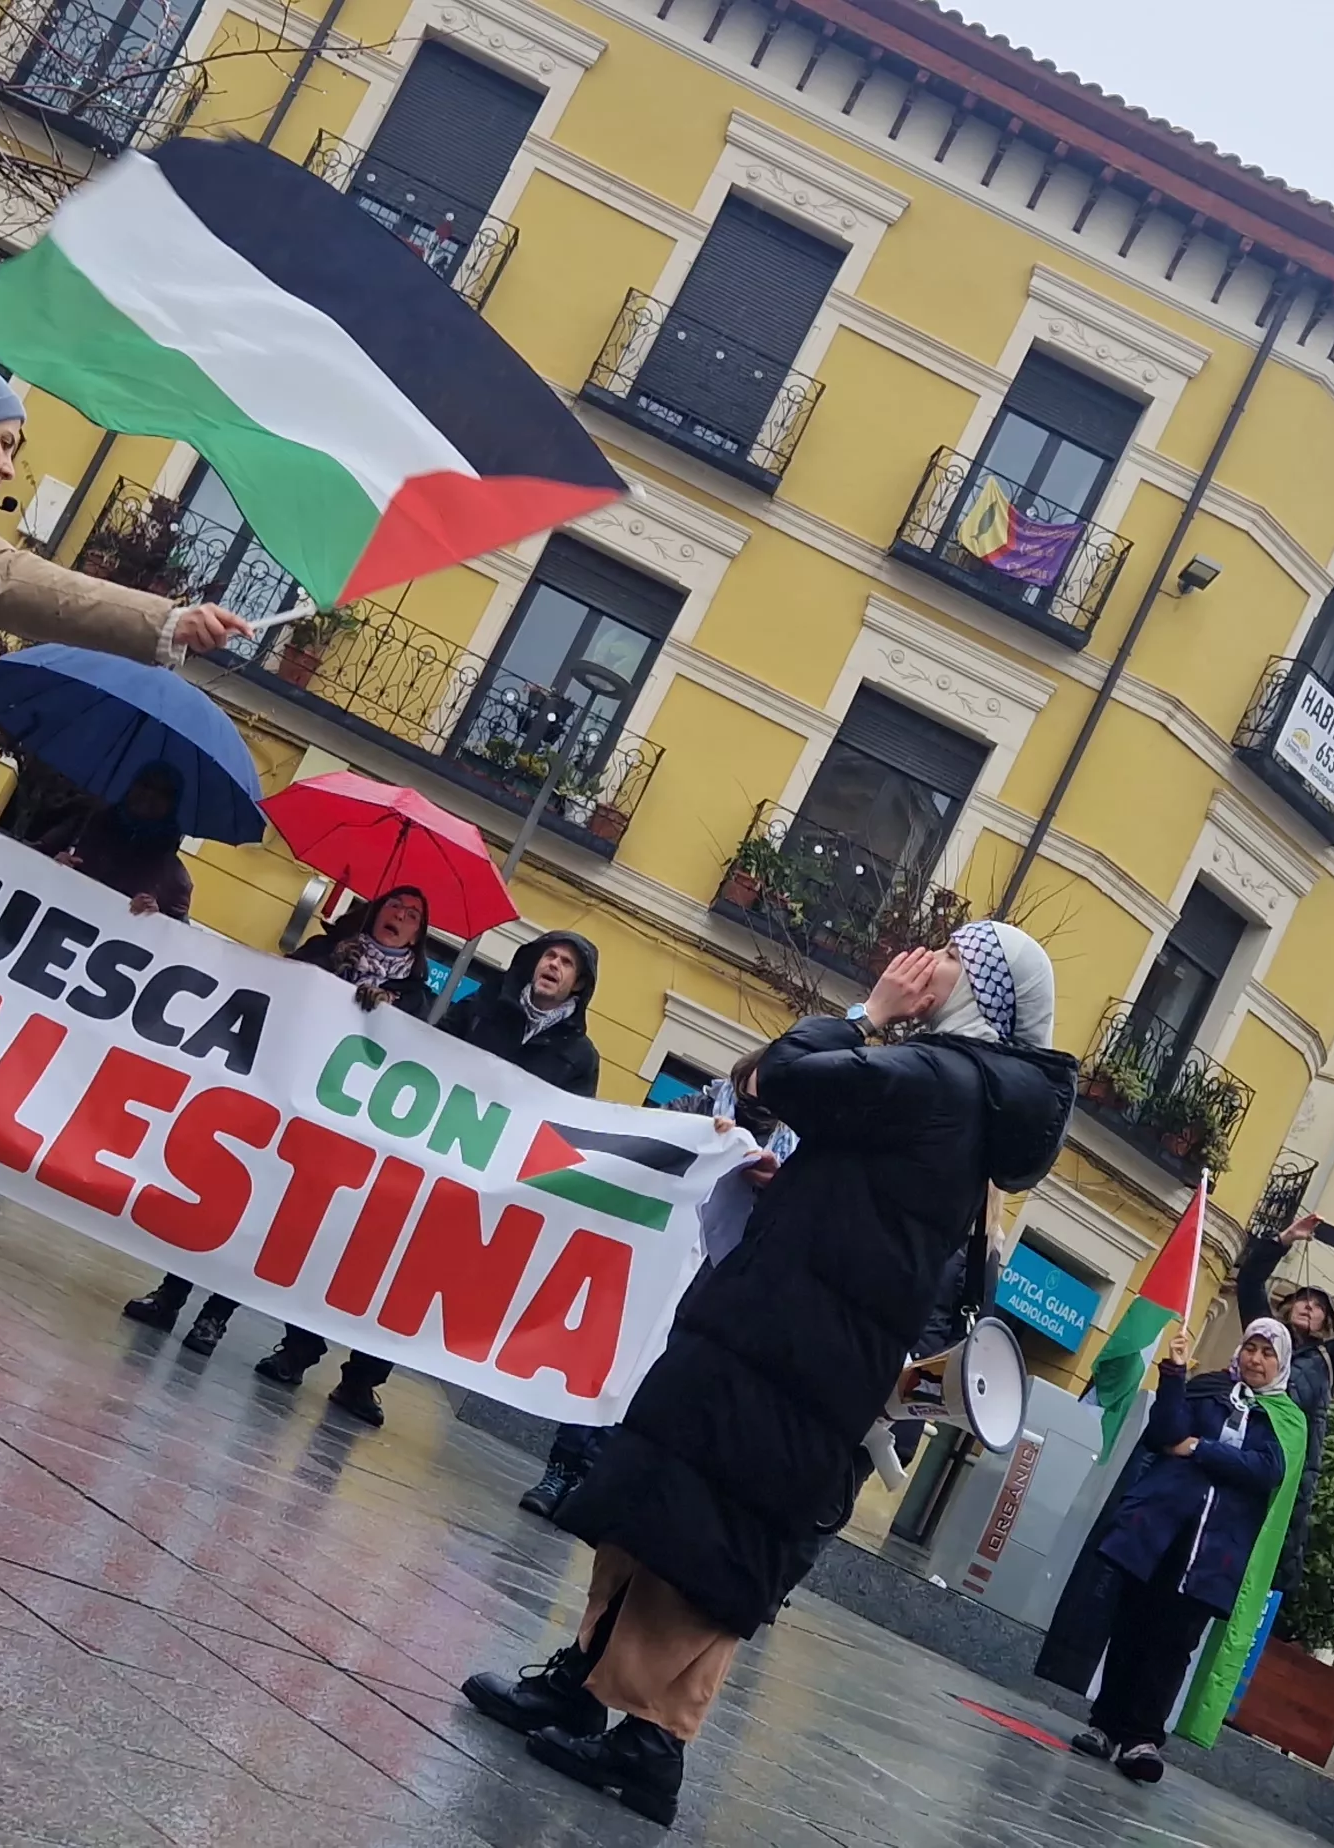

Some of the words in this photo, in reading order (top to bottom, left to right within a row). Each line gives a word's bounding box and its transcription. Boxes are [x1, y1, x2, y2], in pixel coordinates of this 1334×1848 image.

[315, 1034, 511, 1172] CON
[1002, 1265, 1044, 1304] ÓPTICA
[1045, 1296, 1086, 1331] GUARA
